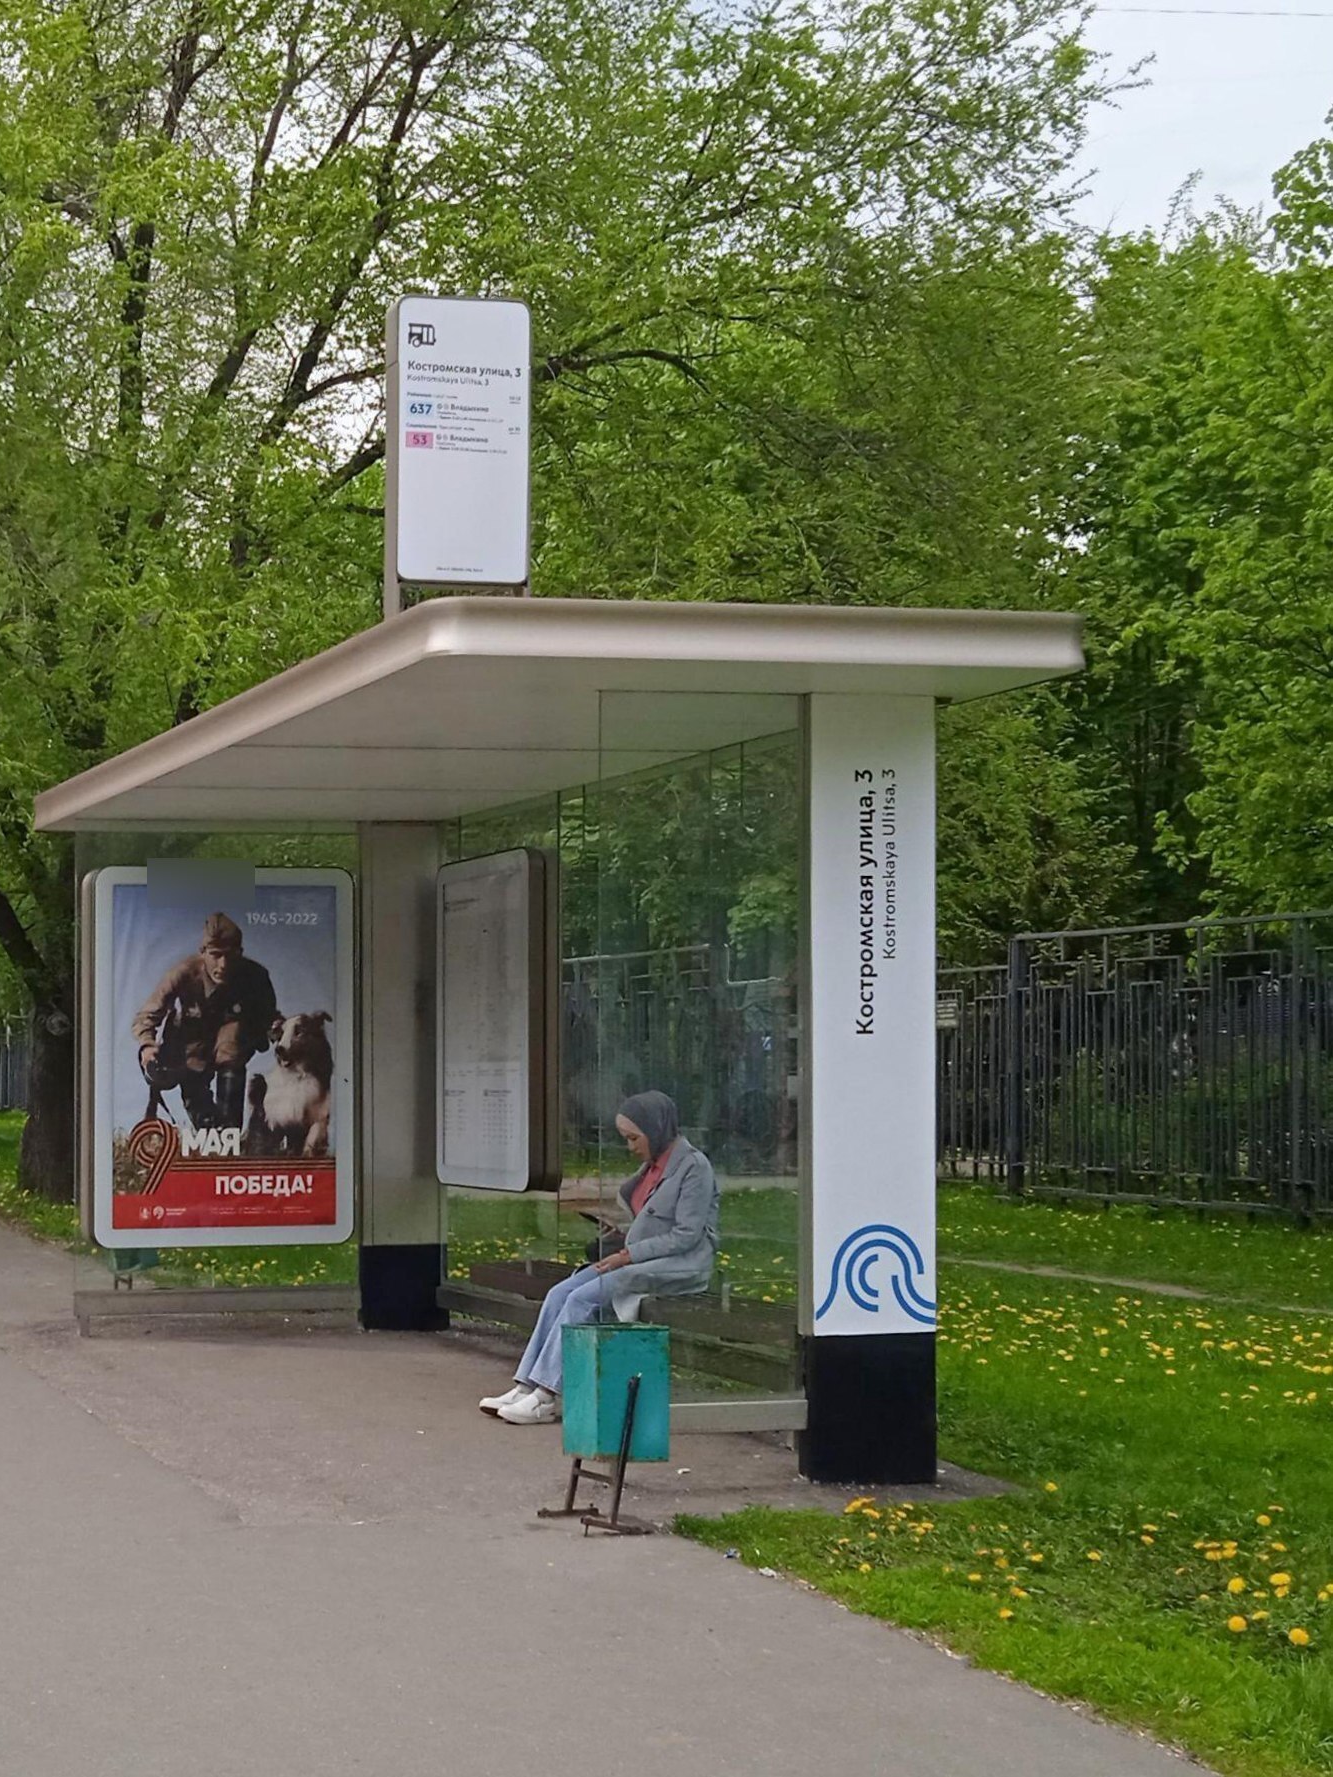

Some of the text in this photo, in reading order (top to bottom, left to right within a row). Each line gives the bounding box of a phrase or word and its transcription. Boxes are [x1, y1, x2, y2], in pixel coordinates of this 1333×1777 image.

[407, 374, 458, 384] Kostromskaya
[408, 360, 521, 379] Костромская улица, 3
[410, 403, 433, 414] 637
[413, 434, 427, 445] 53
[882, 768, 899, 959] Kostromskaya Ulitsa, 3
[855, 769, 878, 1035] Костромская улица, 3
[246, 911, 319, 925] 1945-2022
[180, 1126, 242, 1156] МАЯ
[214, 1174, 314, 1197] ПОБЕДА!
